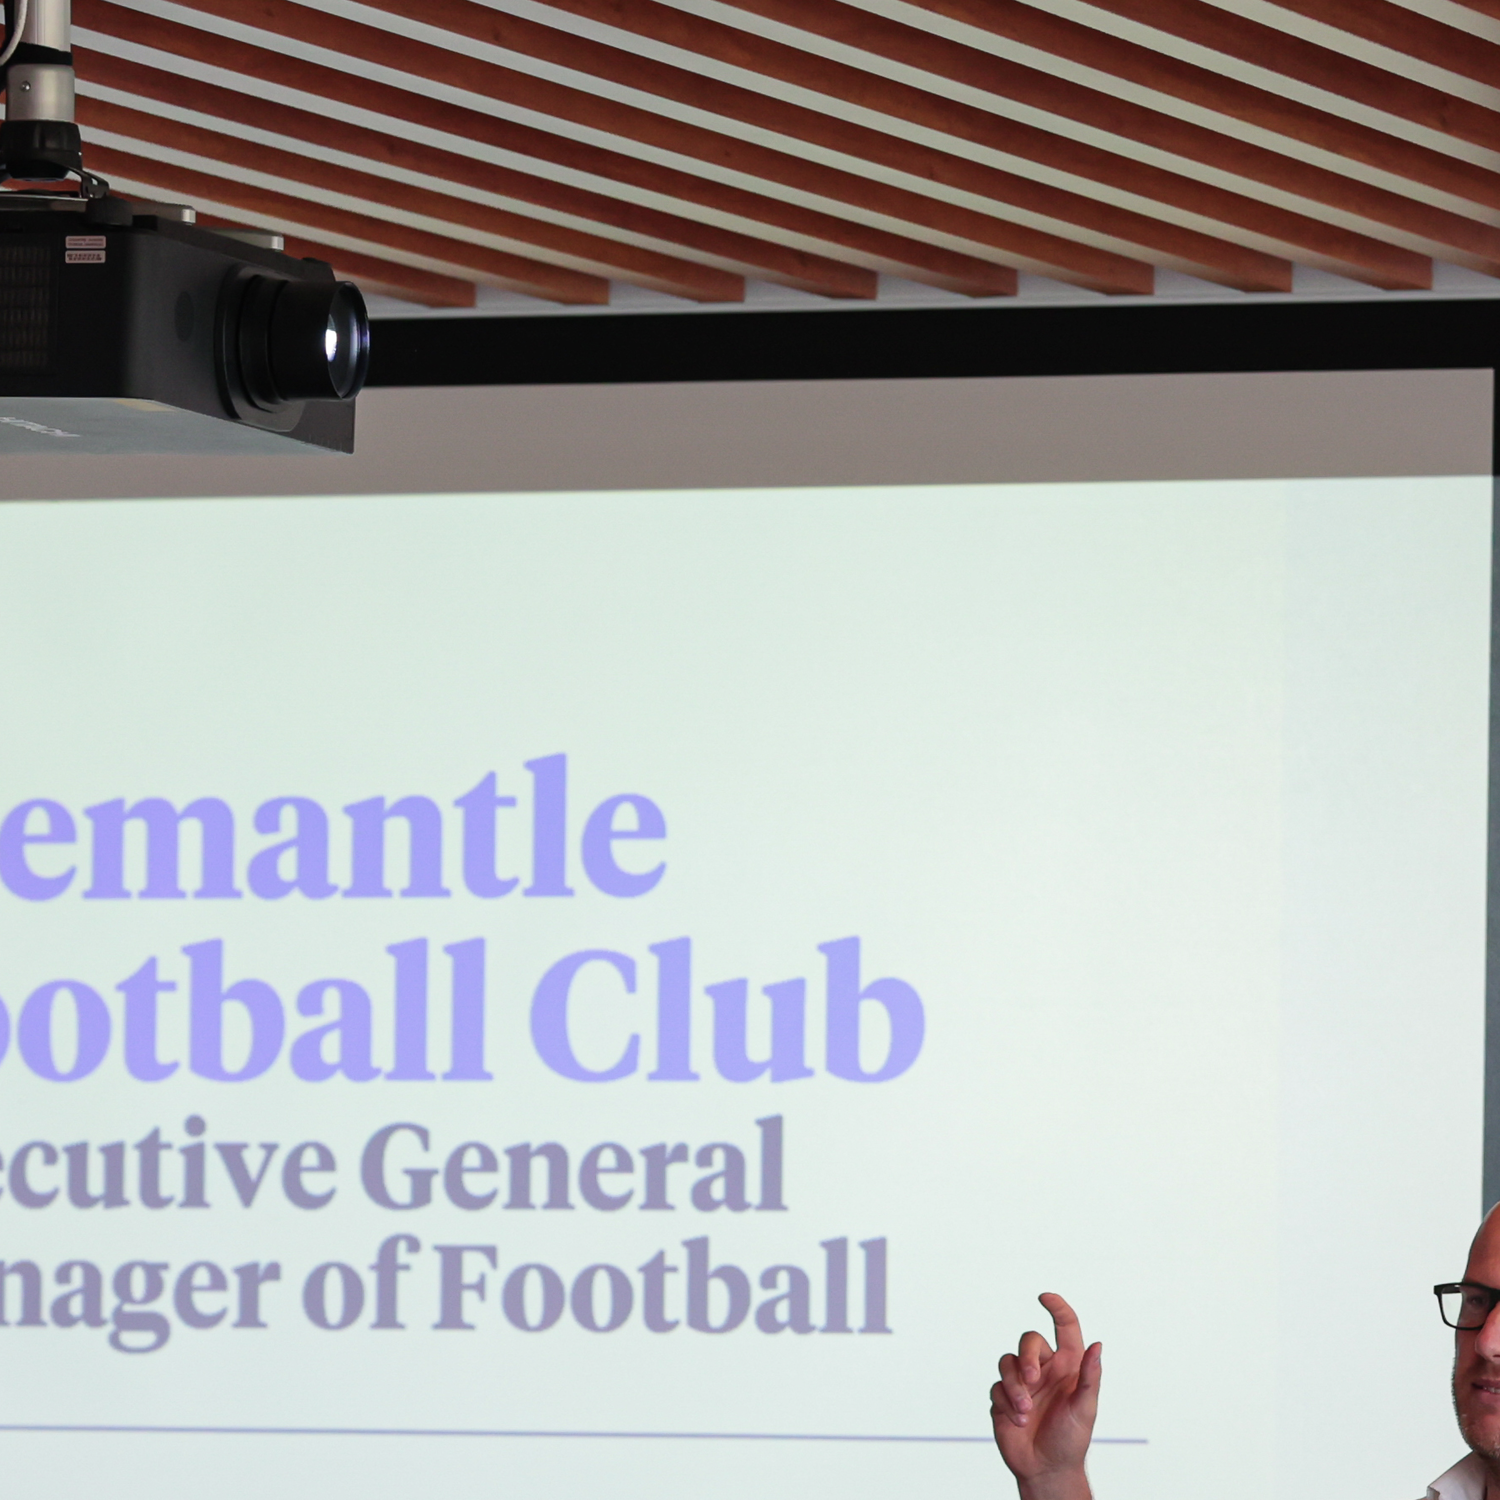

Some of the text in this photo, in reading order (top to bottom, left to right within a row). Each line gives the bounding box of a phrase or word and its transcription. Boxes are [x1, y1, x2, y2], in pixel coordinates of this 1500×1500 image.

[527, 934, 927, 1085] Club
[358, 1112, 790, 1214] General
[300, 1232, 423, 1333] of
[430, 1234, 894, 1337] Football
